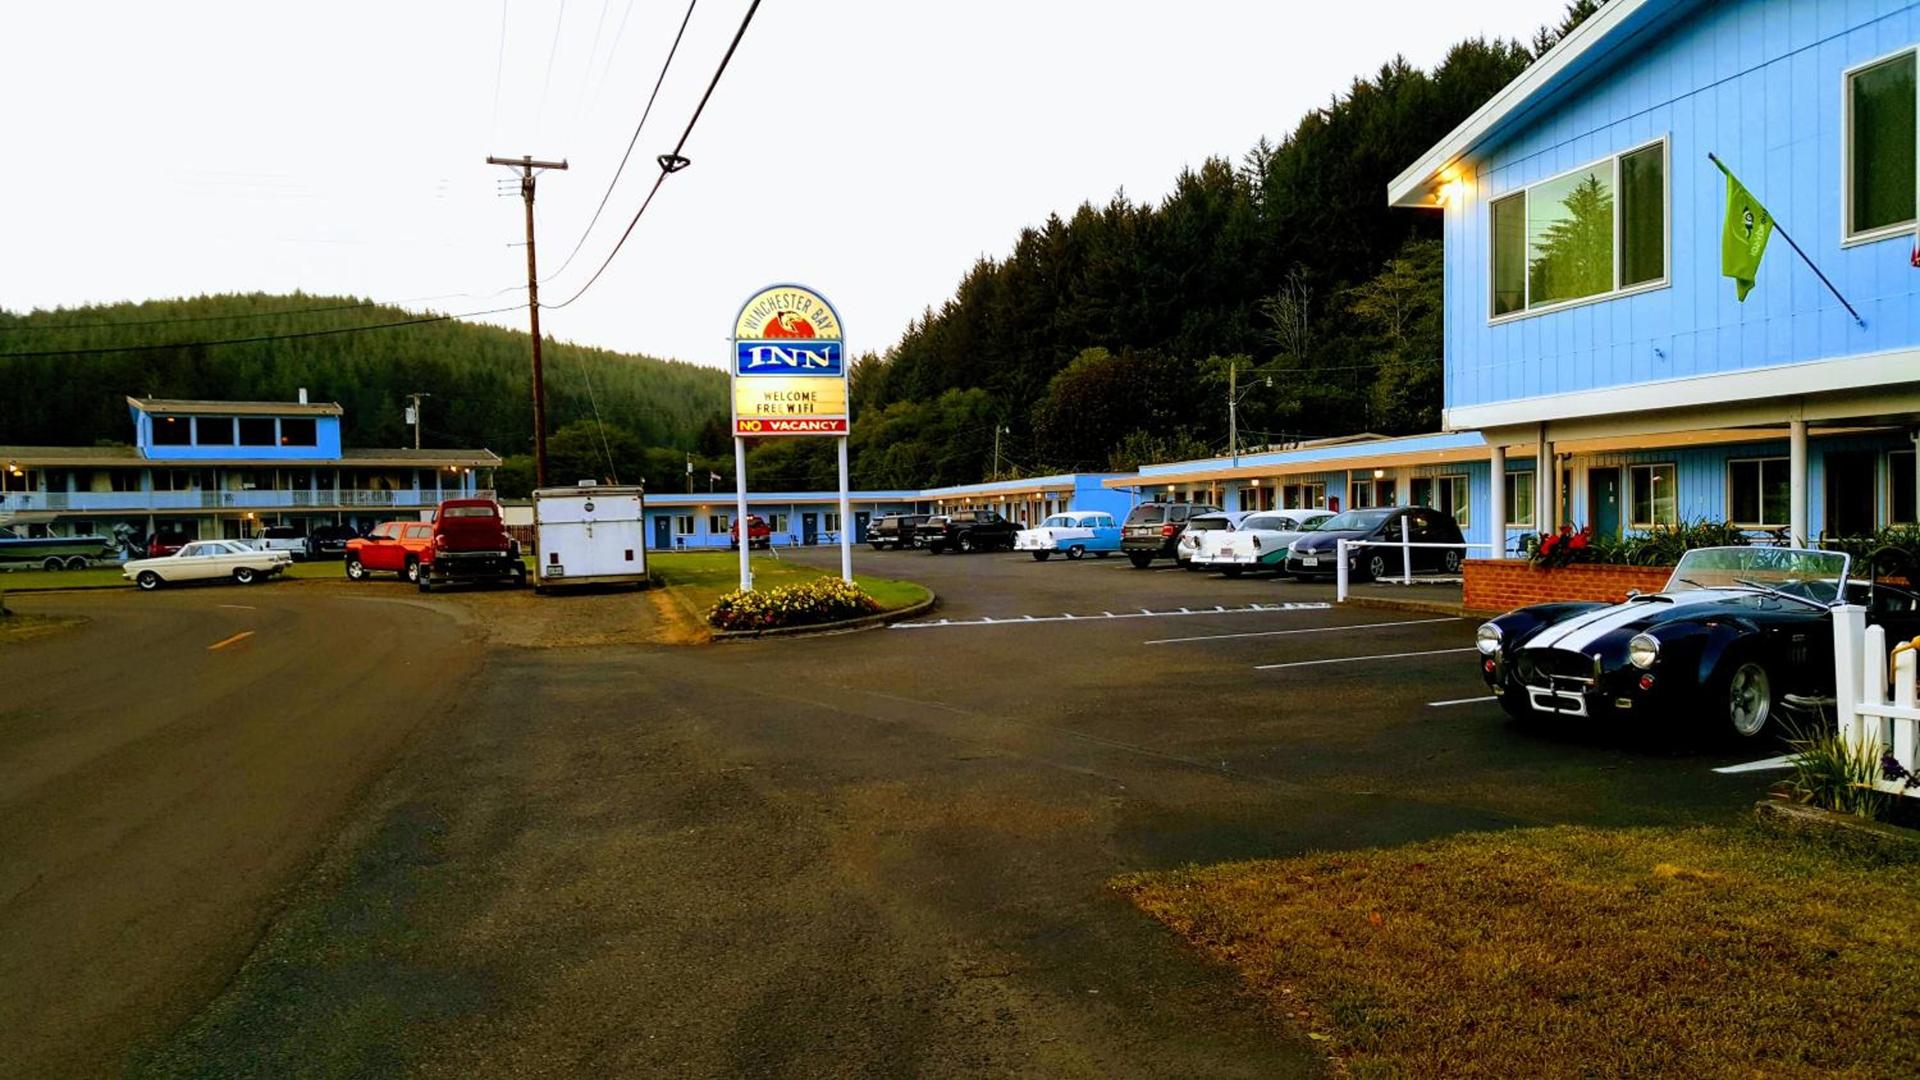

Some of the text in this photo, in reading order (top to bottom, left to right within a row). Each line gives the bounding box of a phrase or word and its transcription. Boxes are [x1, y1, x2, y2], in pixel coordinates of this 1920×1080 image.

[743, 293, 833, 330] WINCHESTER BAY
[747, 345, 832, 369] INN
[764, 391, 817, 402] WELCOME
[756, 403, 814, 414] FREE WIFI
[739, 420, 839, 432] NO VACANCY
